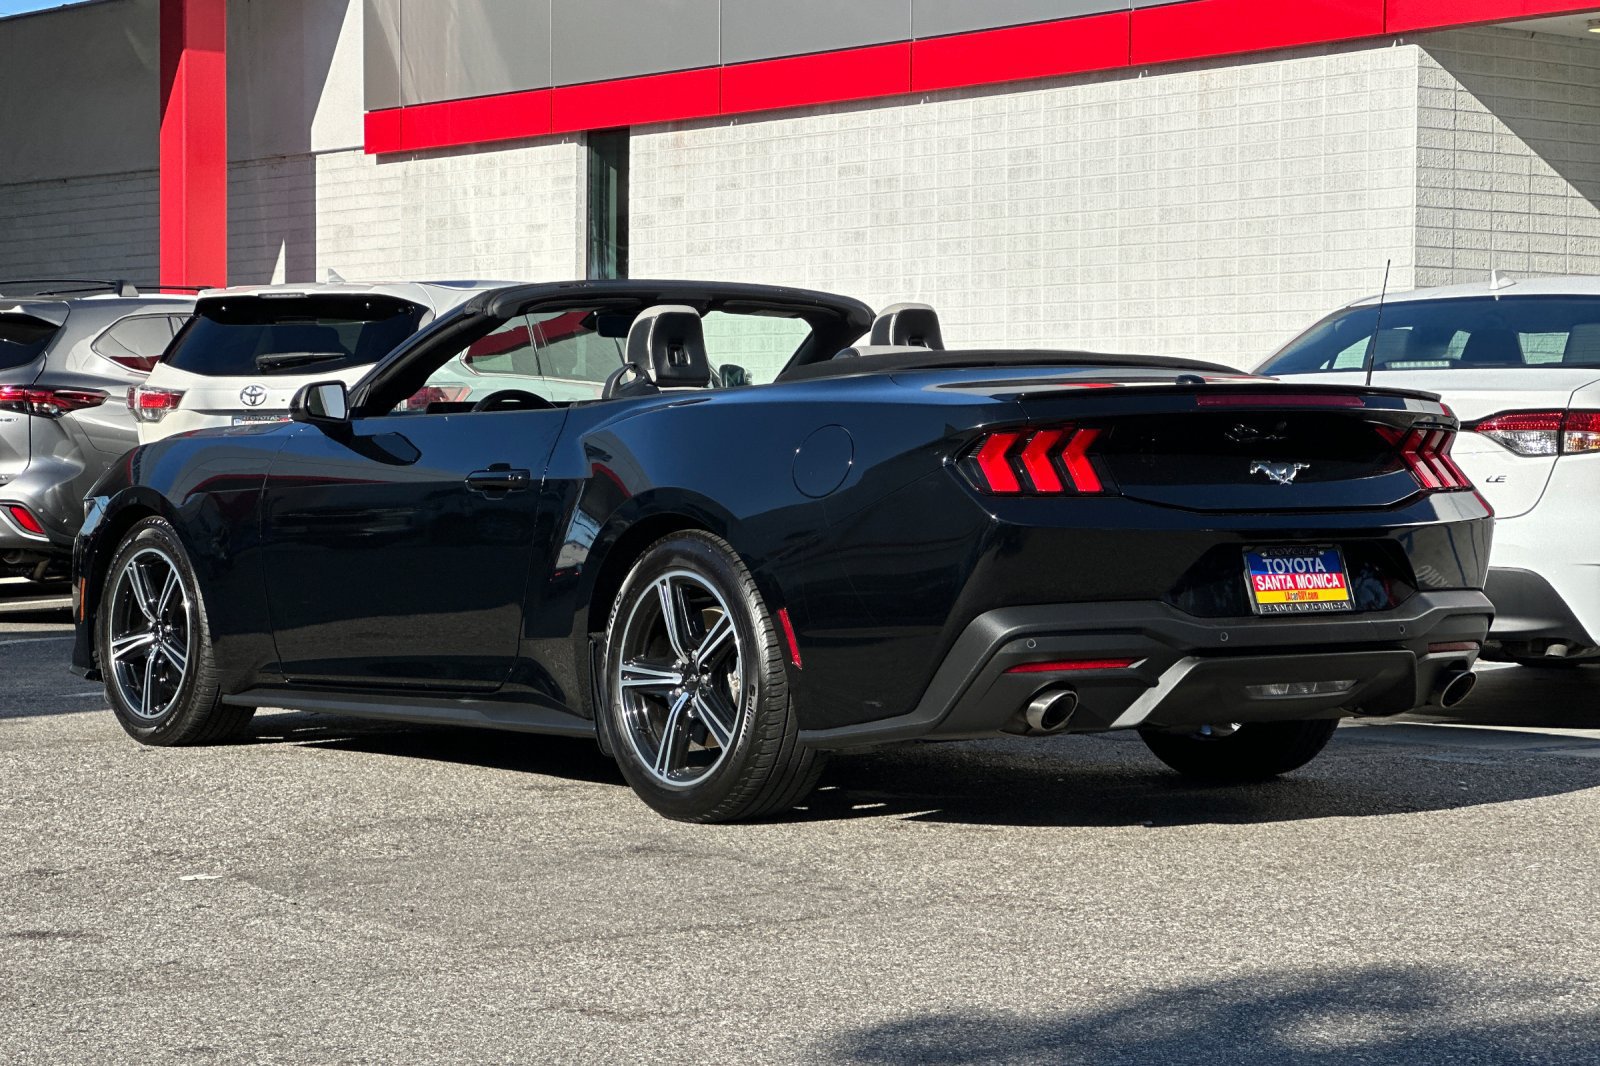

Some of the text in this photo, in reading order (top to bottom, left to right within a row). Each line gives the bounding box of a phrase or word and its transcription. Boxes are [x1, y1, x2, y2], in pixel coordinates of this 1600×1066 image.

[1262, 558, 1327, 574] TOYOTA
[1256, 573, 1341, 591] SANTA MONICA
[1263, 601, 1349, 613] SANTA MONICA
